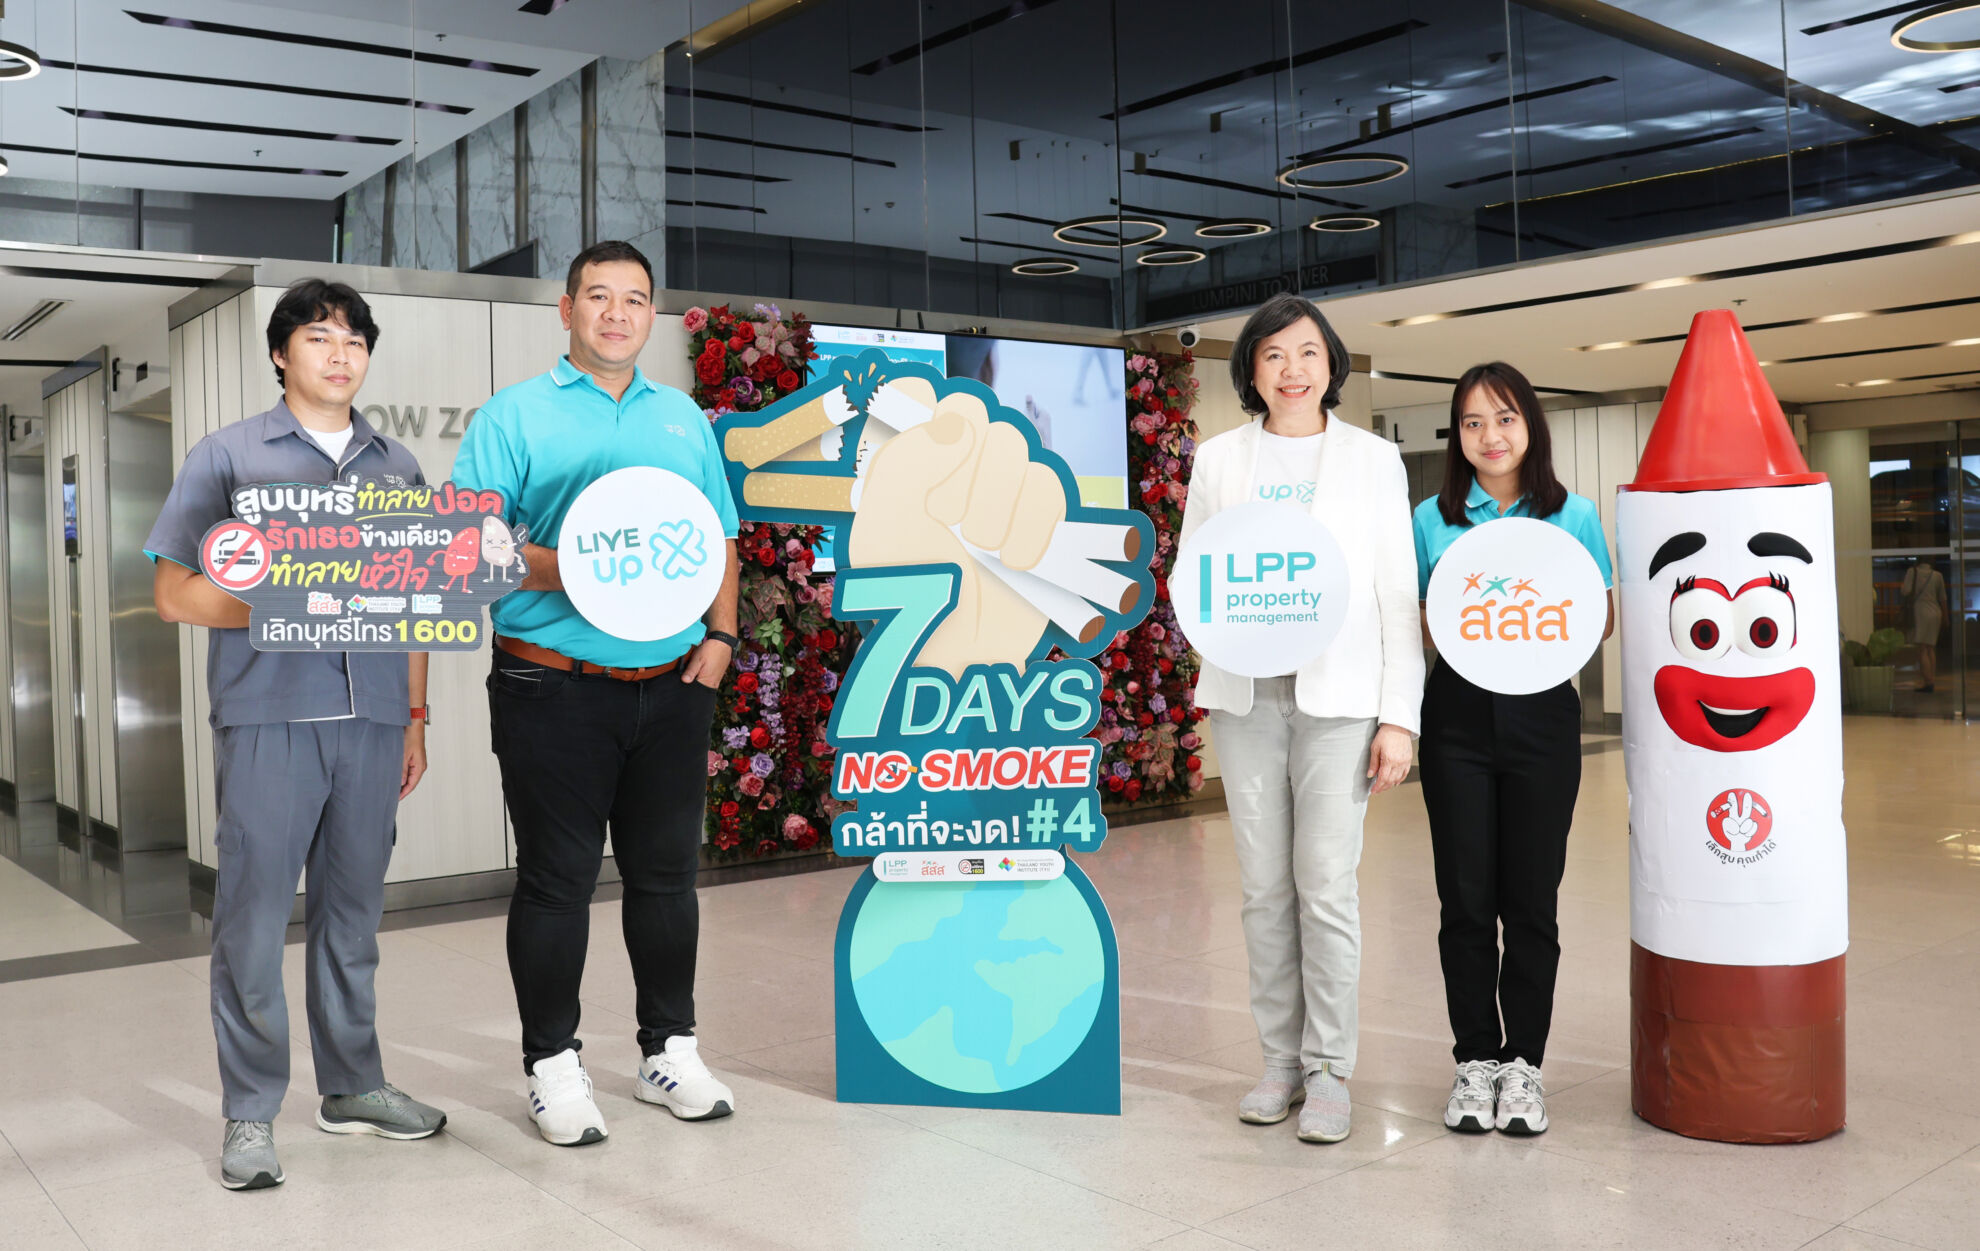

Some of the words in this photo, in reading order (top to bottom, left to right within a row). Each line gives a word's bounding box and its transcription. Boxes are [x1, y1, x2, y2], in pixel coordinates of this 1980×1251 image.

[1192, 284, 1257, 309] LUMPINI
[1226, 551, 1317, 583] LPP
[1226, 588, 1322, 610] property
[395, 619, 477, 642] 1600
[1226, 610, 1319, 626] management
[1459, 599, 1574, 642] สสส
[836, 572, 954, 739] 7
[900, 669, 1094, 735] DAYS
[841, 752, 912, 791] NO
[920, 748, 1092, 789] SMOKE
[1026, 797, 1096, 844] #4
[888, 860, 908, 868] LPP
[921, 865, 945, 876] สสส
